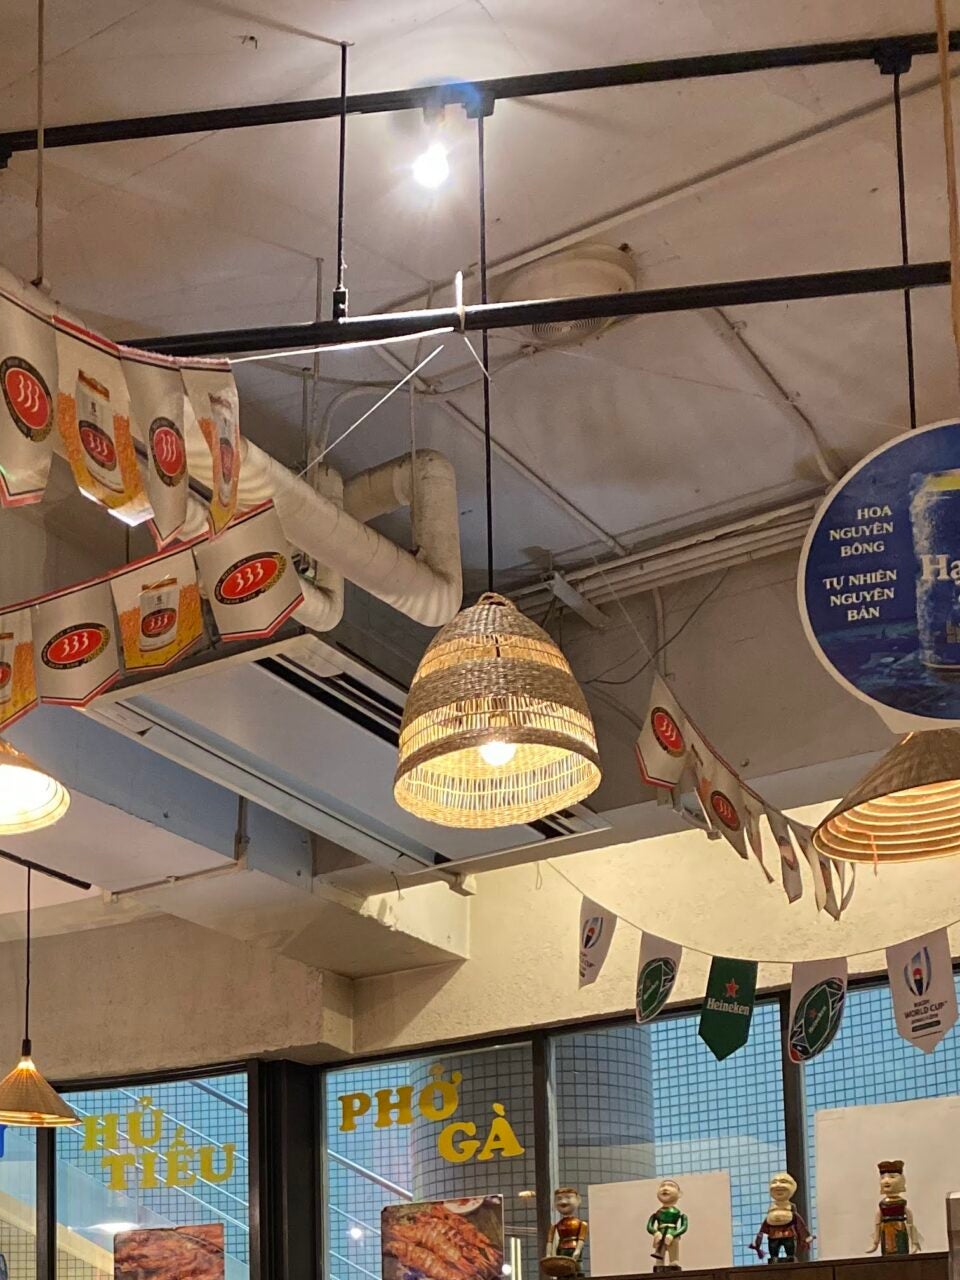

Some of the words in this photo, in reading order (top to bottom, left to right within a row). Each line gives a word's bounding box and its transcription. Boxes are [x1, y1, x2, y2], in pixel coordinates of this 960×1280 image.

[16, 374, 40, 414] 333
[88, 432, 109, 457] 333
[160, 432, 178, 464] 333
[856, 504, 893, 521] HOA
[828, 520, 895, 542] NGUYÊN
[840, 541, 886, 559] BÔNG
[234, 562, 264, 594] 333
[848, 568, 898, 588] NHIÊN
[828, 586, 896, 608] NGUYÊN
[149, 612, 169, 628] 333
[62, 631, 90, 658] 333
[659, 718, 677, 742] 333
[706, 997, 750, 1017] Heineken
[338, 1063, 463, 1133] PHỞ
[81, 1095, 165, 1152] HỦ
[437, 1102, 526, 1163] GÀ
[101, 1126, 237, 1192] TIẾU
